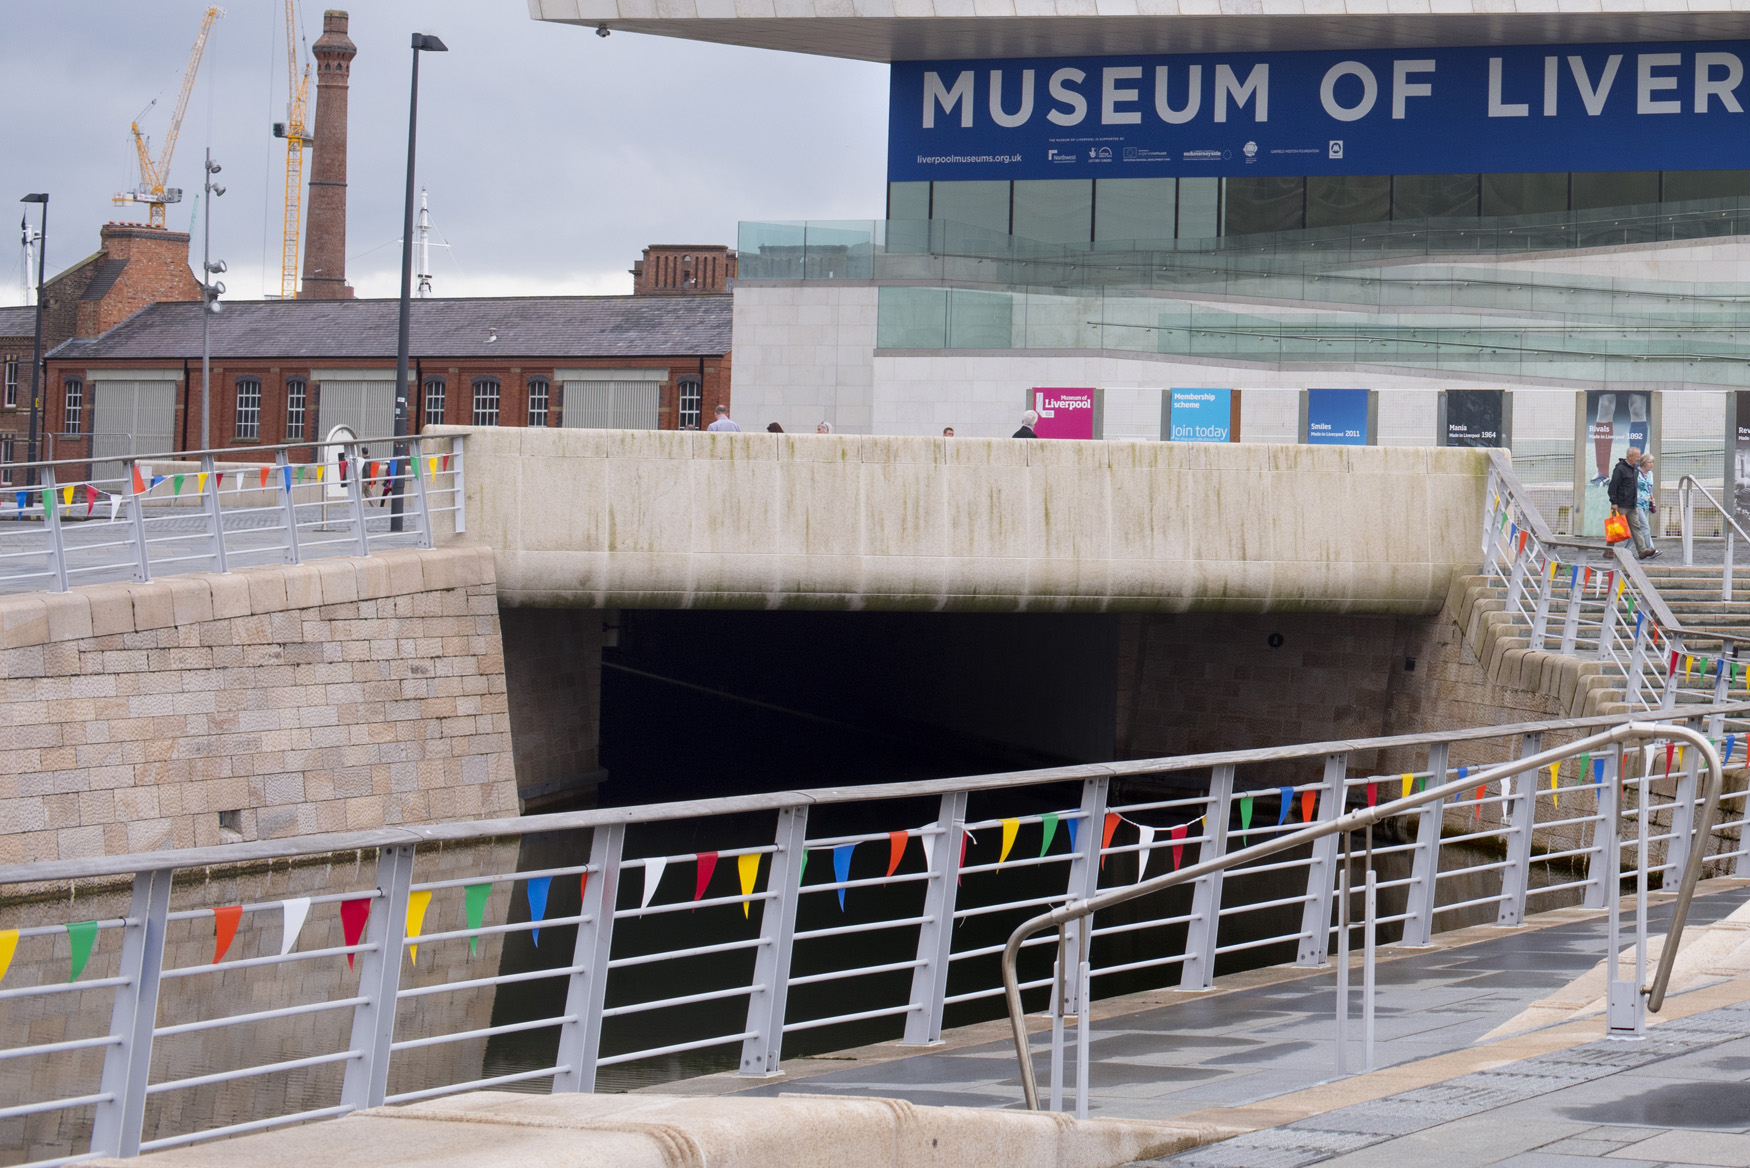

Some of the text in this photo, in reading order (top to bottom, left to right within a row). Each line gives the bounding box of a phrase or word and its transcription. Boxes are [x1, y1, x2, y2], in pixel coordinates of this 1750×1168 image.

[922, 63, 1269, 128] MUSEUM
[1320, 59, 1436, 122] OF
[917, 154, 1022, 164] liverpoolmuseums.org.uk
[1174, 393, 1216, 402] Membership
[1045, 399, 1091, 410] Liverpool
[1172, 424, 1227, 440] Join today
